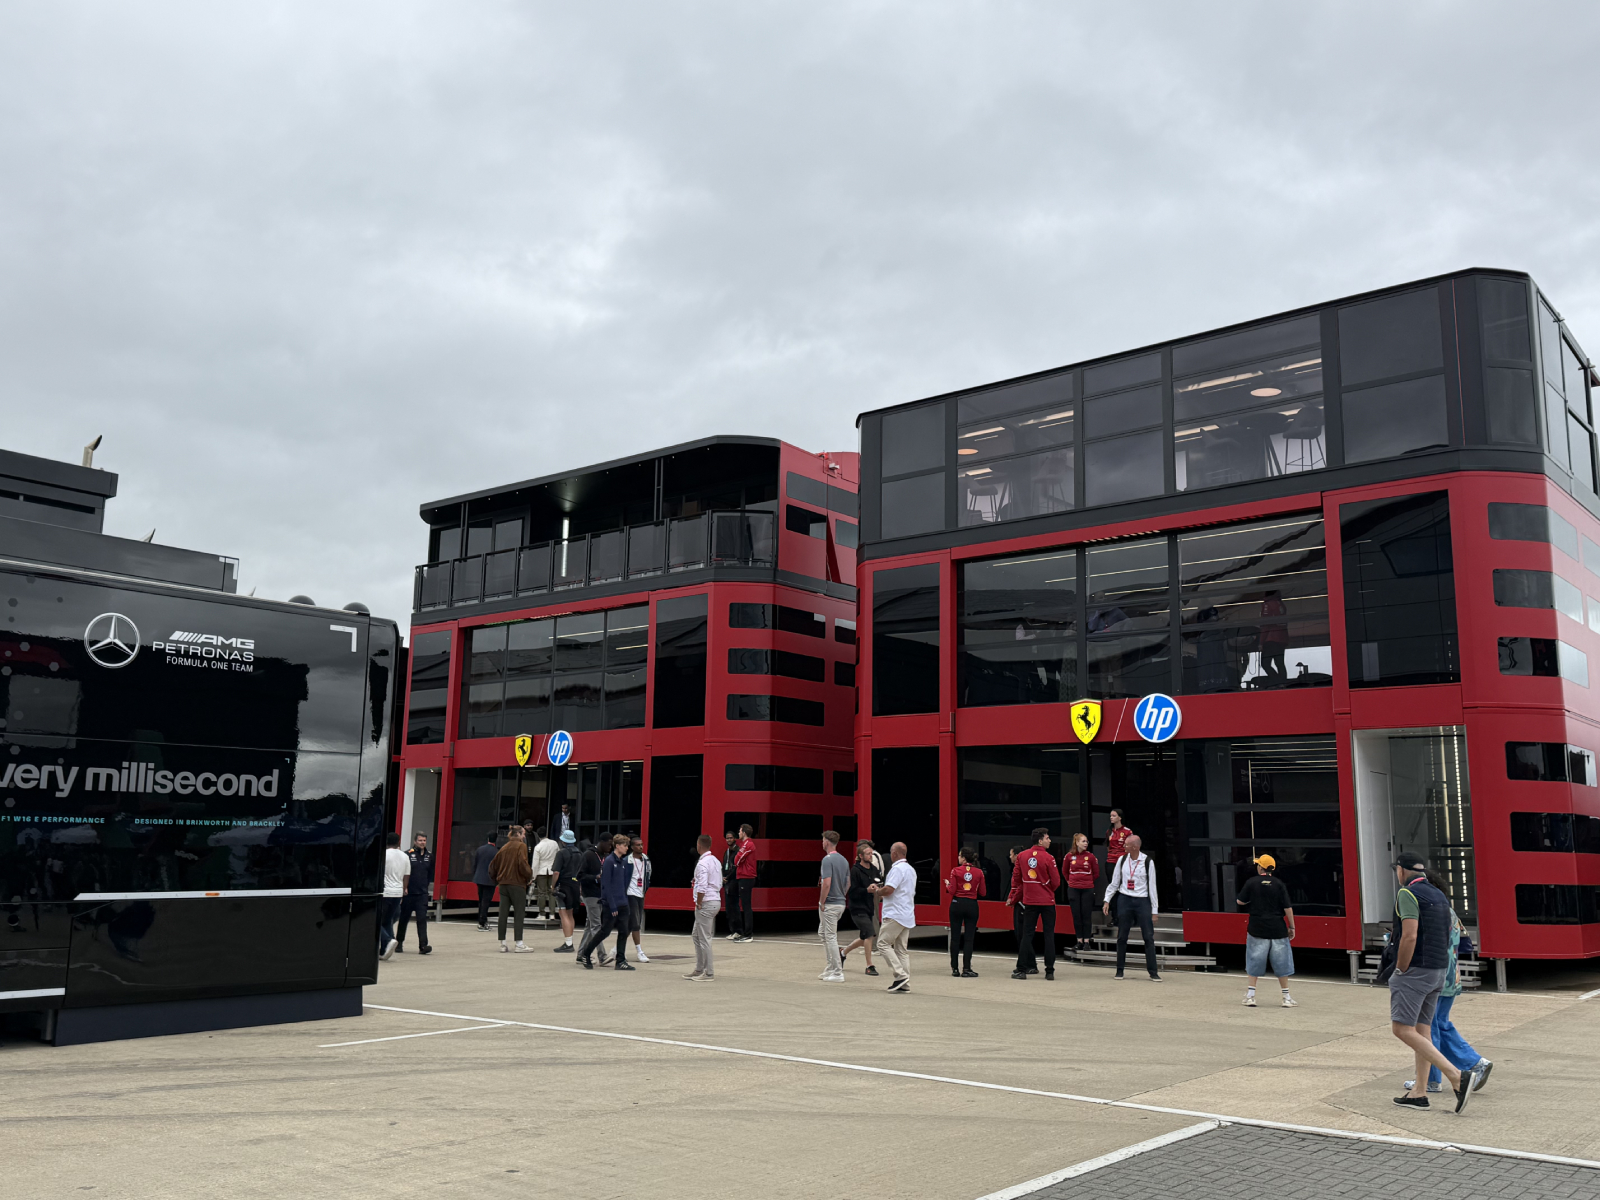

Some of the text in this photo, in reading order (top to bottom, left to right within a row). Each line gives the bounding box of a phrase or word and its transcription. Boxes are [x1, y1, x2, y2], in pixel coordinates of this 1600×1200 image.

[152, 641, 254, 662] PETRONAS
[166, 655, 254, 673] FORMULA ONE TEAM
[1140, 694, 1175, 741] hp
[550, 731, 569, 764] hp
[85, 761, 279, 797] millisecond
[42, 816, 105, 824] PERFORMANCE
